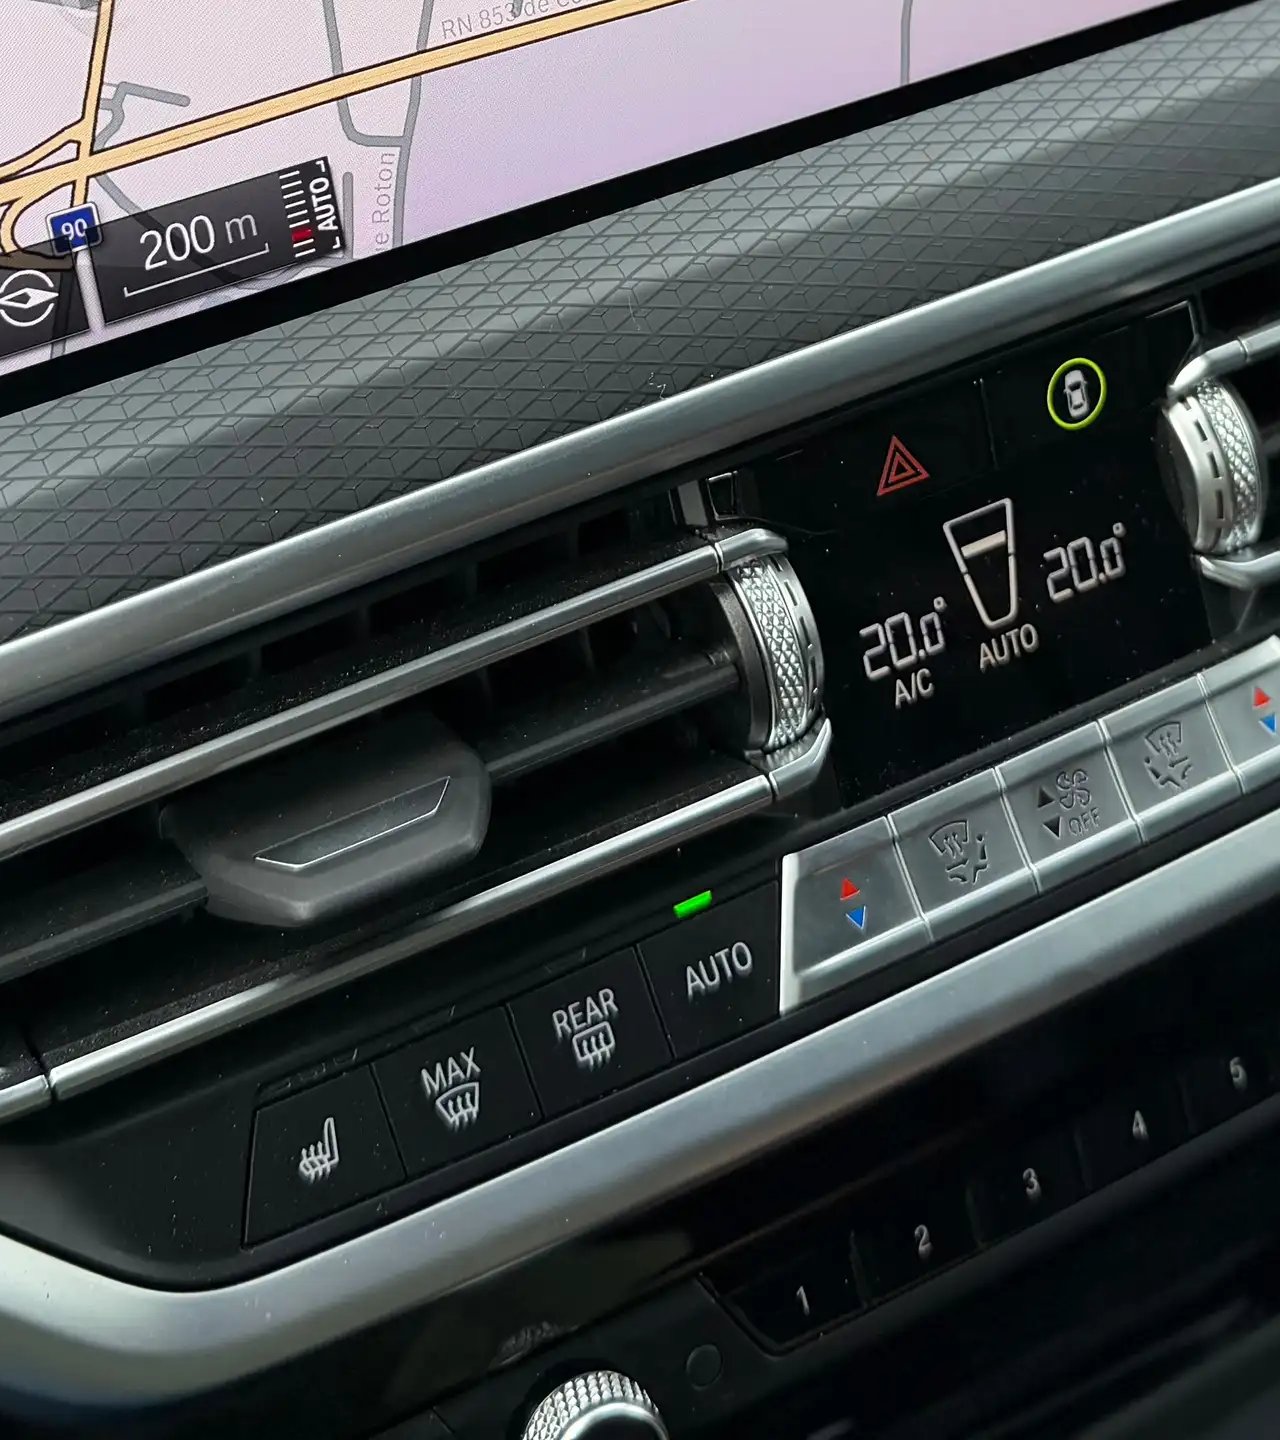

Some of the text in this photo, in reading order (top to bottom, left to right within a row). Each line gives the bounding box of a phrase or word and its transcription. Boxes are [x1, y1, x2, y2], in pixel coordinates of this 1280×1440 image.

[441, 15, 473, 40] RN
[479, 2, 518, 30] 853
[310, 176, 339, 232] AUTO
[371, 152, 396, 224] Roton
[60, 218, 89, 239] 90
[139, 213, 258, 271] 200 m
[979, 623, 1040, 671] AUTO
[893, 667, 934, 709] A/C
[1068, 806, 1101, 837] OFF
[684, 940, 753, 1000] AUTO
[551, 987, 620, 1041] REAR
[421, 1047, 482, 1097] MAX
[1228, 1055, 1248, 1090] 5
[1130, 1108, 1149, 1143] 4
[1022, 1167, 1042, 1202] 3
[913, 1223, 933, 1258] 2
[796, 1285, 811, 1317] 1
